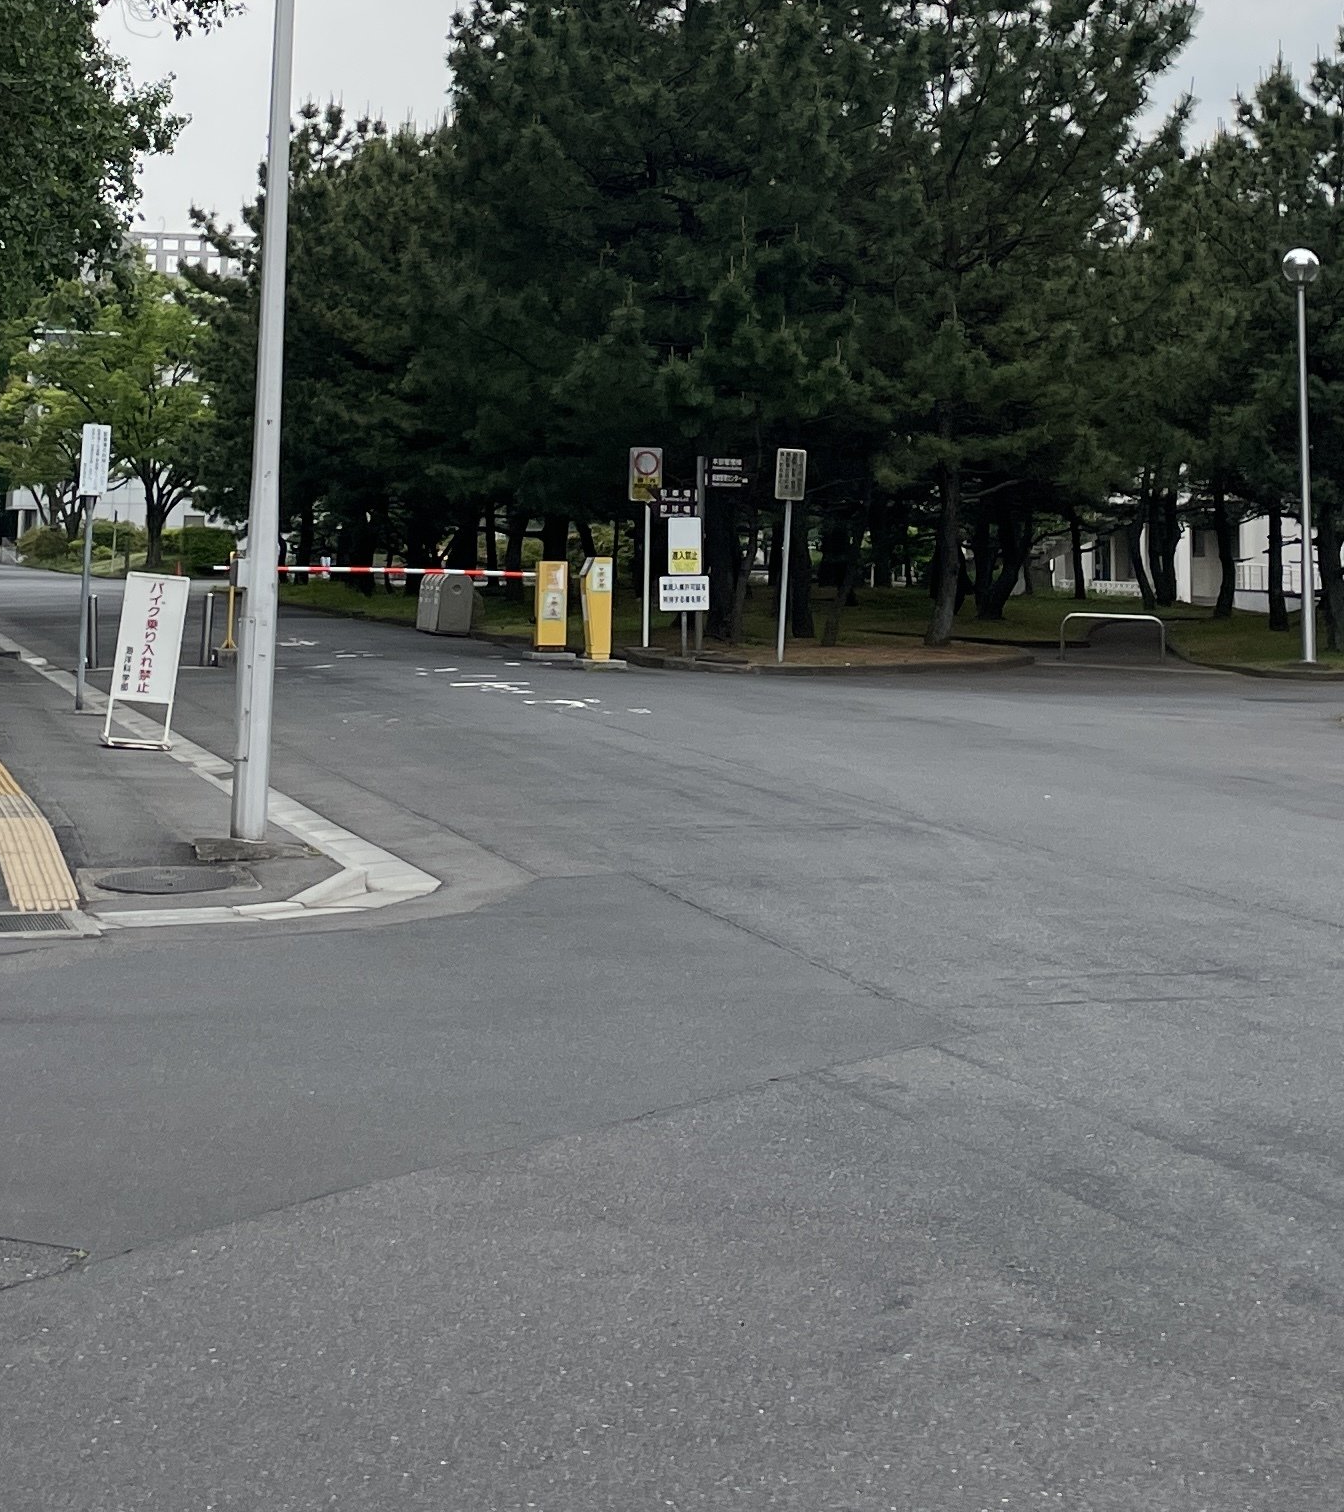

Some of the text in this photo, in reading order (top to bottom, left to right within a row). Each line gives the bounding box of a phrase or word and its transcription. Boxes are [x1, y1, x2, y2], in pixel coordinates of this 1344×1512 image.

[136, 582, 165, 694] バイク乗り入れ禁止
